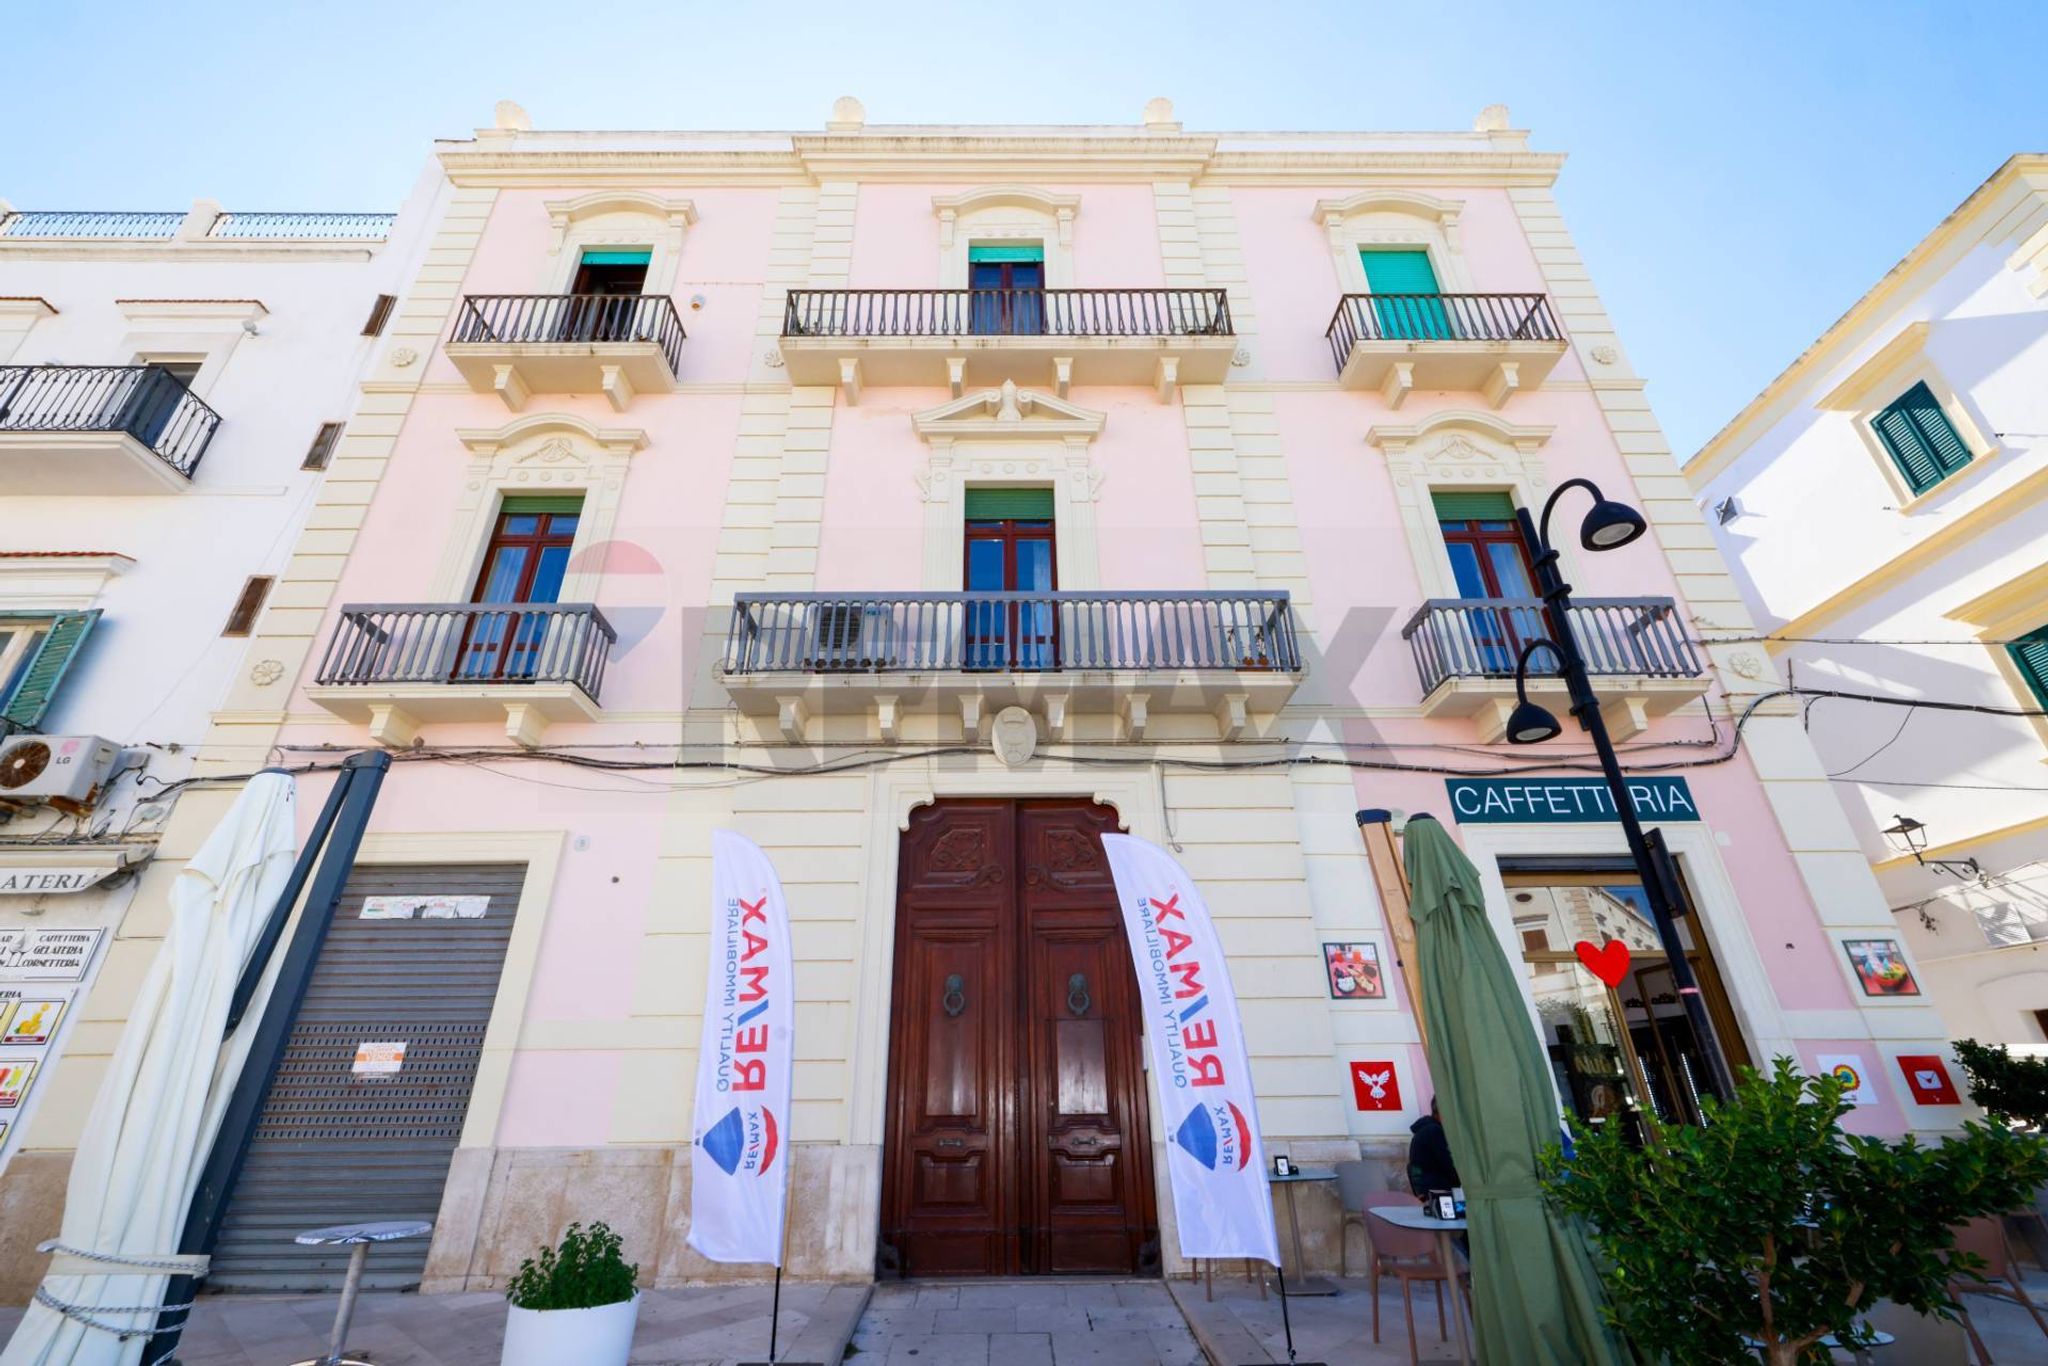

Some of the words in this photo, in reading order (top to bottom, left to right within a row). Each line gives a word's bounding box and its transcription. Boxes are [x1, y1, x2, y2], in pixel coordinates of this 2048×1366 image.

[56, 757, 71, 765] LG
[1, 874, 97, 889] ATERI
[33, 946, 83, 954] GELATERIA
